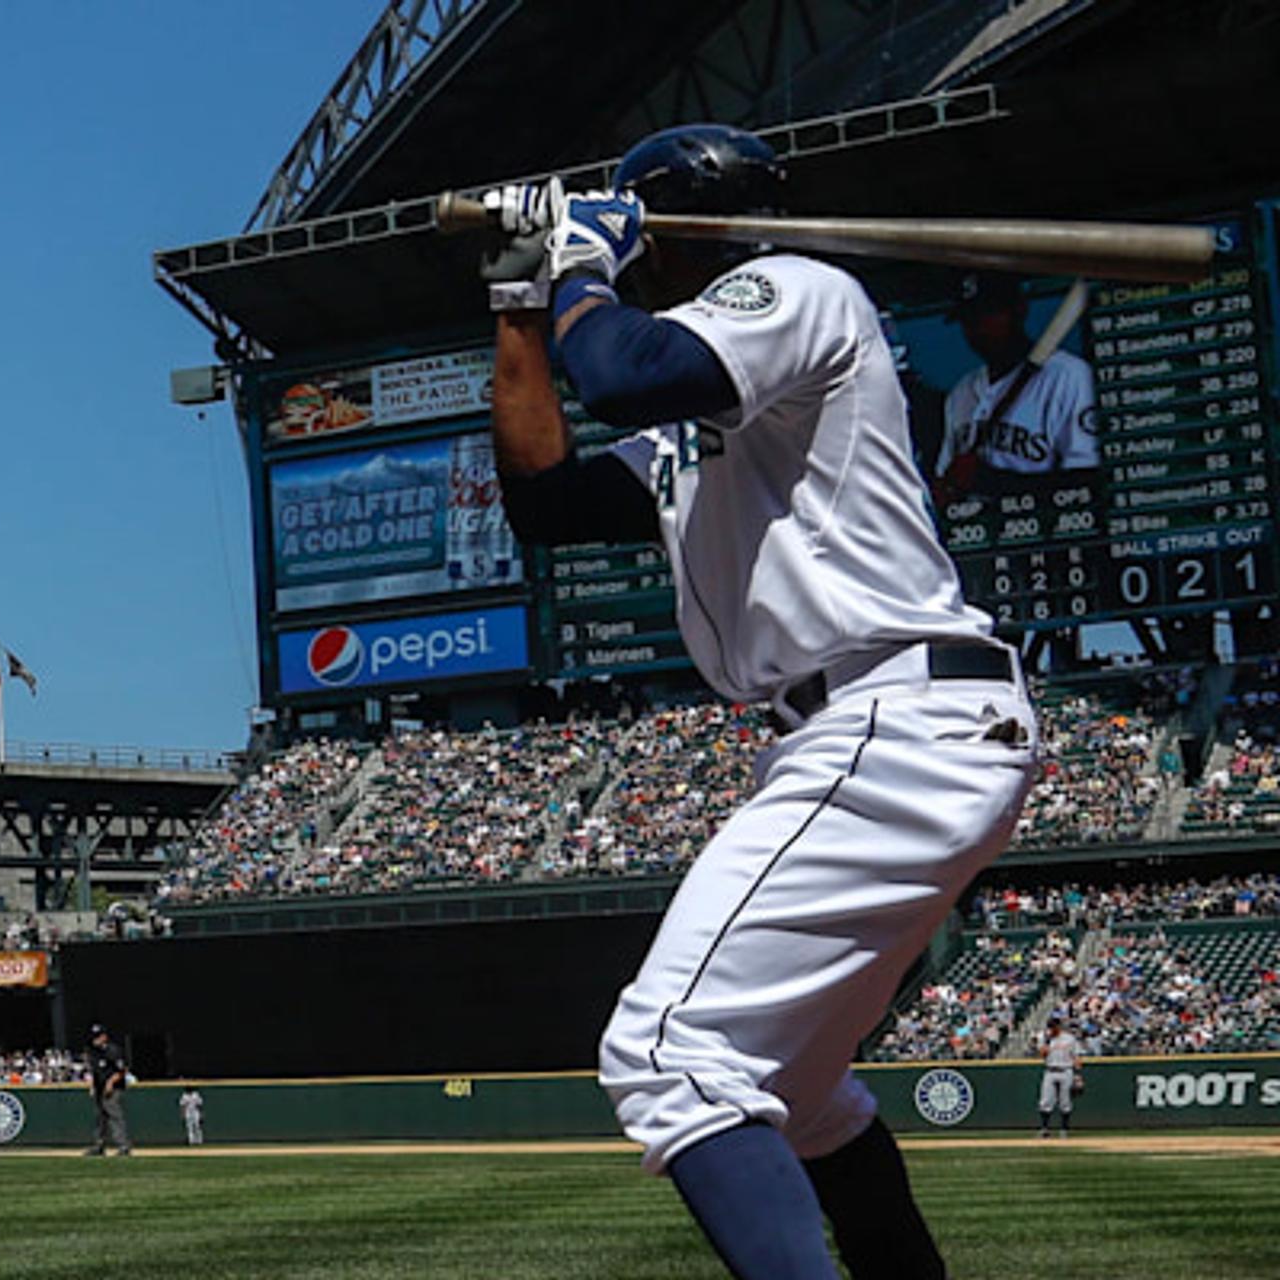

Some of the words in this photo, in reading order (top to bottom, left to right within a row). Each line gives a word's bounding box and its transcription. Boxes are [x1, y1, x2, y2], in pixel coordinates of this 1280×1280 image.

[1116, 311, 1159, 329] Jones
[1192, 300, 1216, 318] CF
[1118, 332, 1189, 355] Saunders
[1098, 367, 1114, 382] 17
[381, 391, 412, 409] THE
[418, 383, 469, 401] PATIO
[1122, 386, 1176, 405] Seager
[1123, 412, 1176, 430] Zunino
[1206, 403, 1220, 418] C
[1104, 444, 1121, 458] 13
[1204, 428, 1224, 444] LF
[1251, 449, 1265, 463] K
[282, 499, 337, 530] GET
[345, 486, 436, 522] AFTER
[1214, 505, 1228, 522] P
[1235, 501, 1269, 519] 3.73
[282, 533, 300, 556] A
[304, 523, 373, 554] COLD
[378, 514, 433, 543] ONE
[1110, 542, 1152, 560] BALL
[1157, 531, 1217, 552] STRIKE
[1225, 526, 1263, 546] OUT
[574, 581, 629, 598] Scherzer
[995, 575, 1011, 595] 0
[1031, 570, 1047, 590] 2
[1068, 565, 1085, 585] 0
[1119, 565, 1150, 604] 0
[1176, 559, 1206, 598] 2
[1235, 552, 1257, 591] 1
[997, 604, 1013, 623] 2
[1070, 594, 1086, 616] 0
[585, 621, 635, 641] Tigers
[371, 618, 486, 675] pepsi
[587, 646, 655, 665] Mariners
[1137, 1072, 1255, 1106] ROOT
